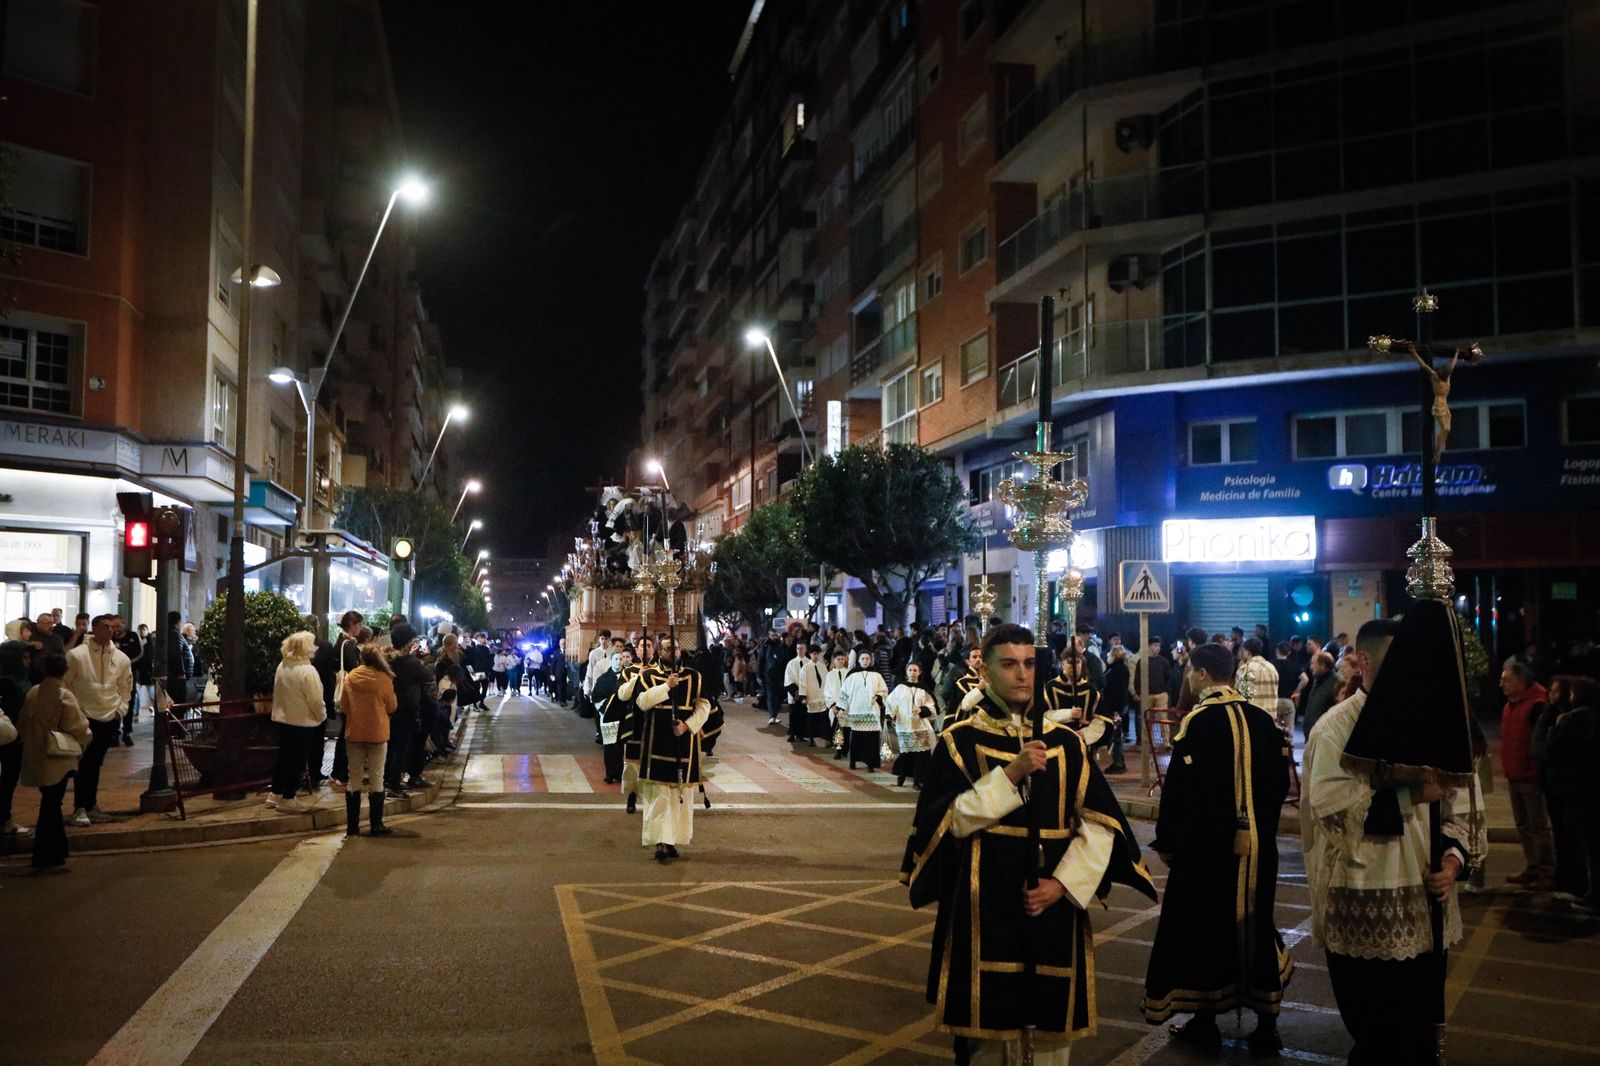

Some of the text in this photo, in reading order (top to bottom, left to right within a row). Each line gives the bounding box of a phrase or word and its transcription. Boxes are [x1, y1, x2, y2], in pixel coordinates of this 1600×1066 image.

[4, 423, 85, 449] MERAKI
[1200, 490, 1246, 501] Medicina
[1248, 488, 1261, 500] de
[1371, 487, 1408, 498] Centro
[1165, 522, 1313, 559] Phonika
